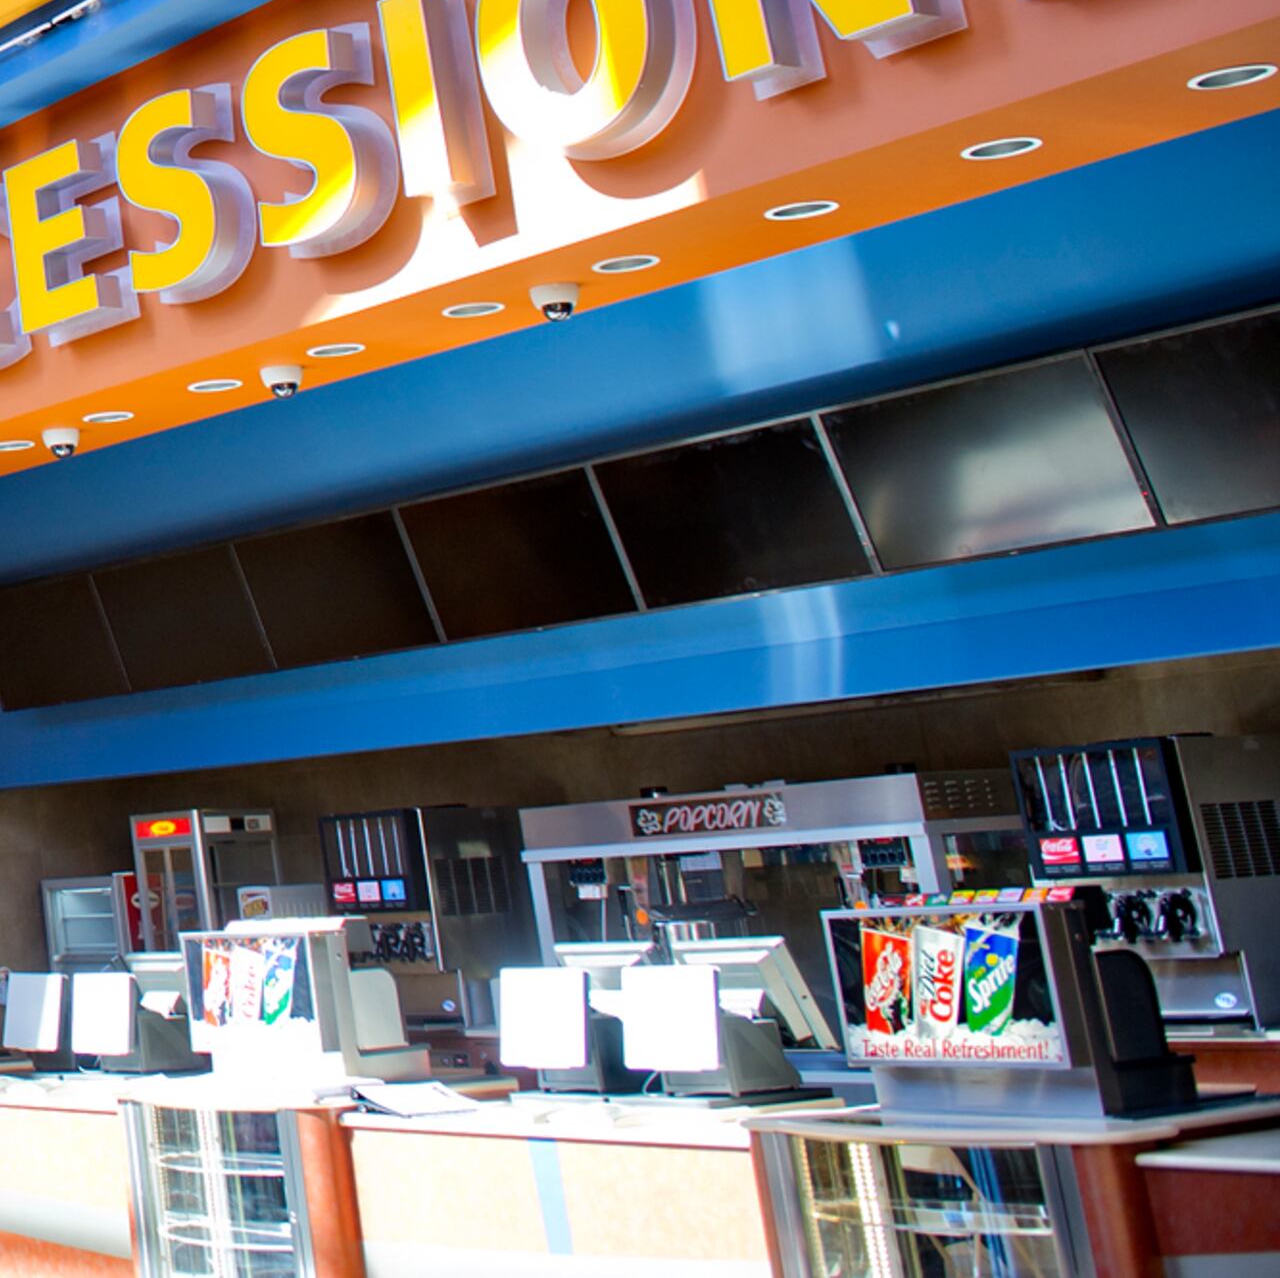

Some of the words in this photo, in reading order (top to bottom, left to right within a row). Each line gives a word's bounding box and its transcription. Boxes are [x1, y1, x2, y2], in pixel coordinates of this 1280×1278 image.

[663, 800, 761, 833] POPCORN
[929, 950, 955, 1022] Coke
[968, 955, 1015, 1014] Sprite
[862, 1038, 899, 1058] Taste
[904, 1038, 937, 1058] Real
[941, 1037, 1049, 1059] Refreshment!
